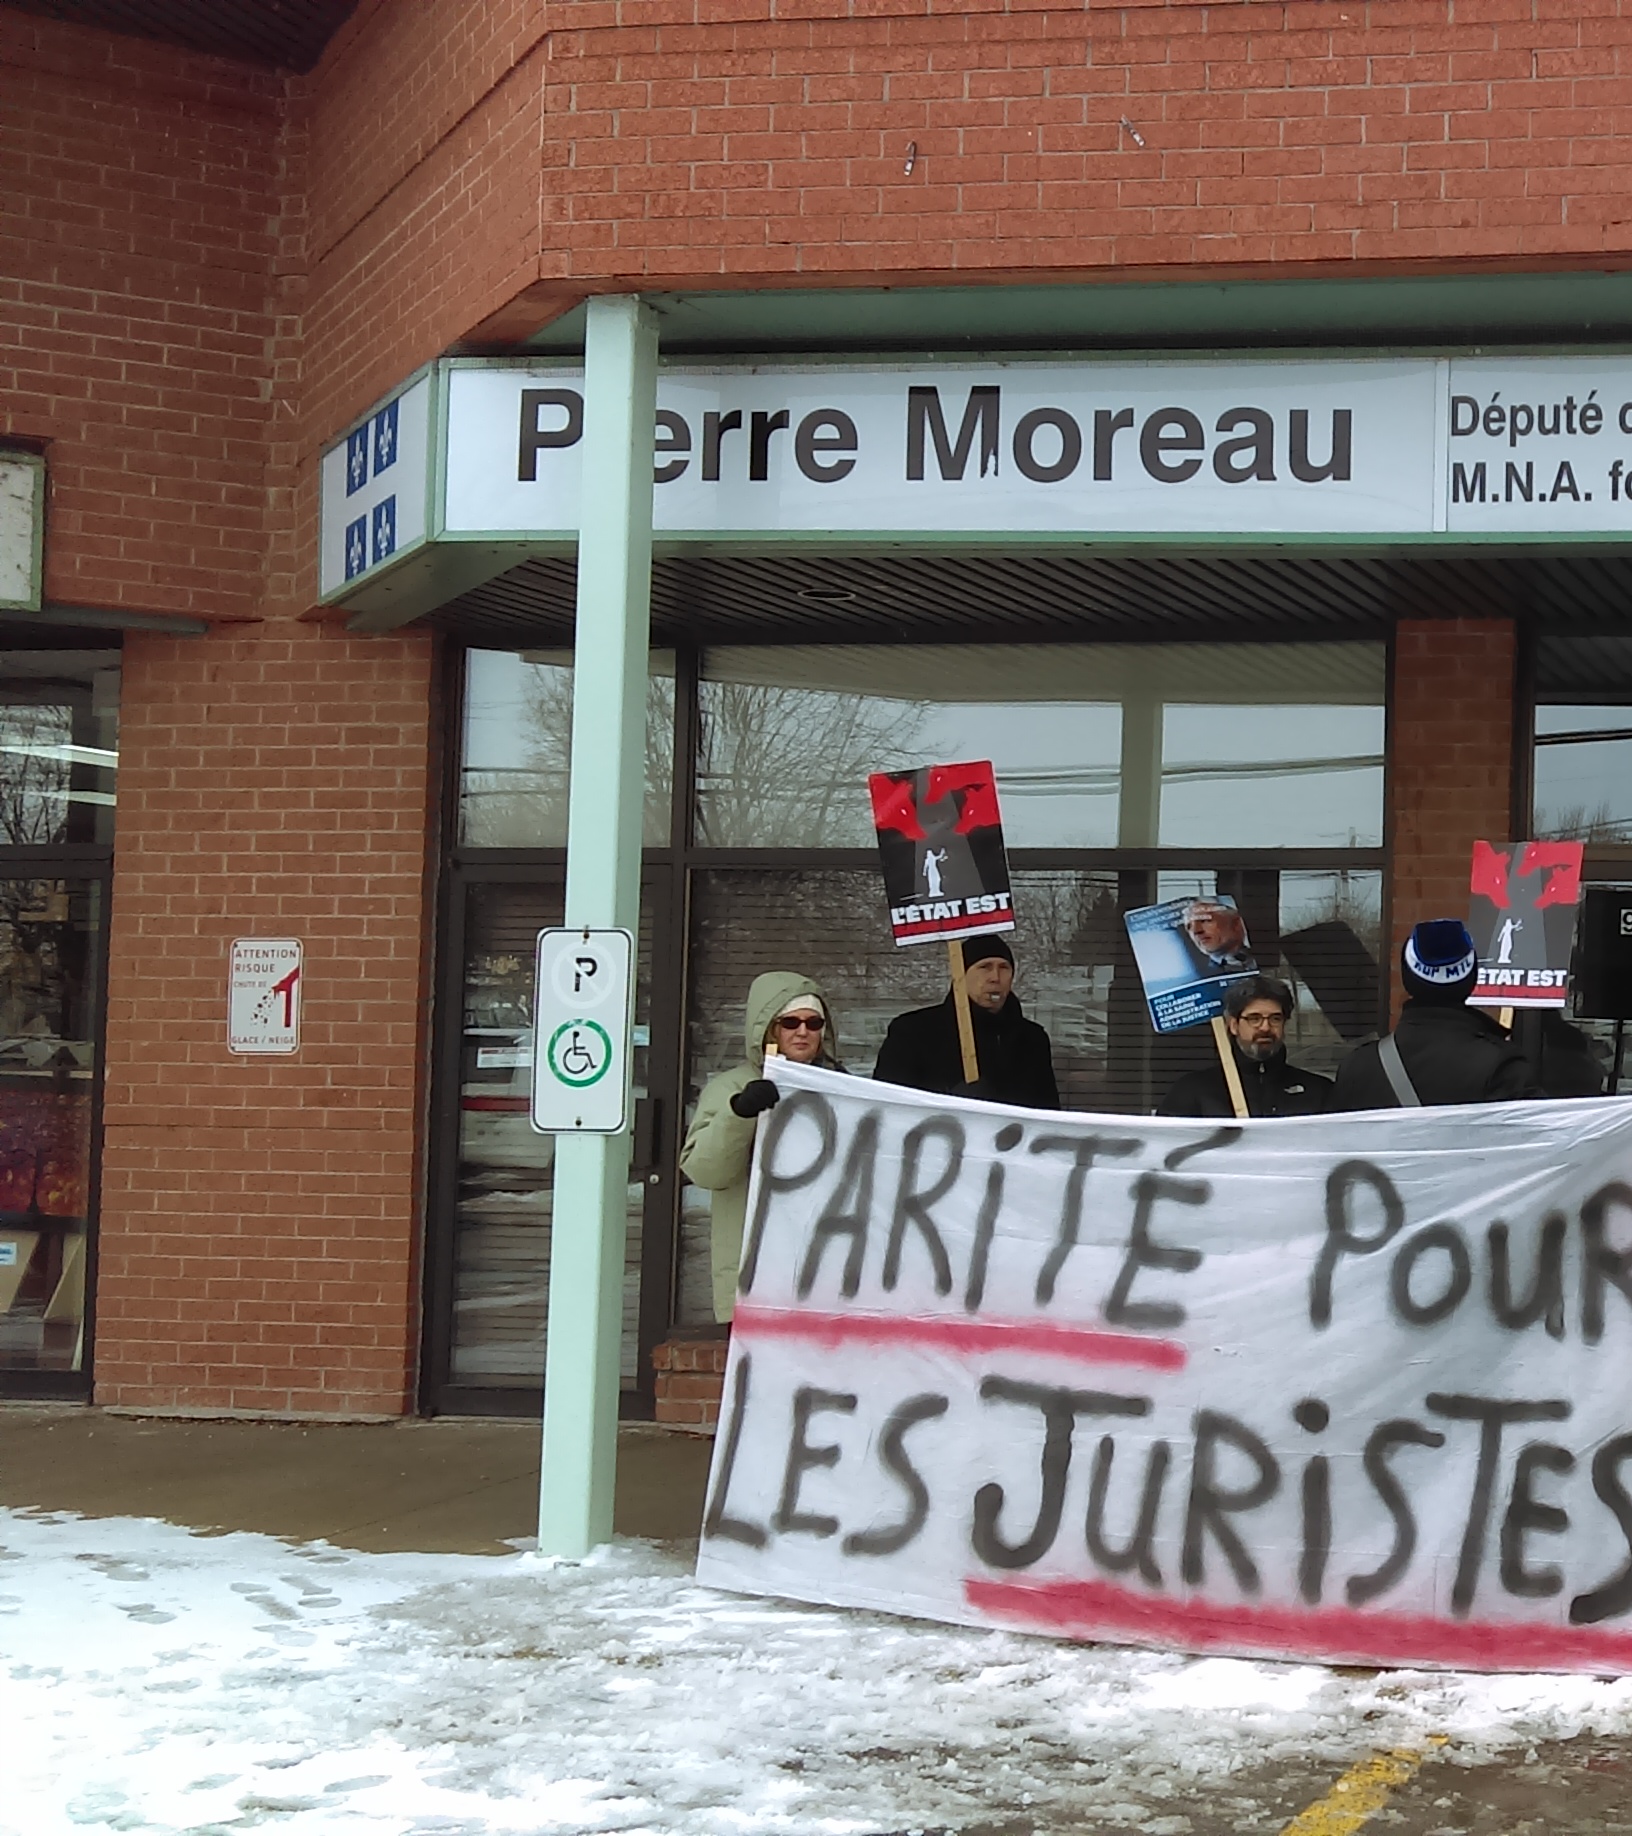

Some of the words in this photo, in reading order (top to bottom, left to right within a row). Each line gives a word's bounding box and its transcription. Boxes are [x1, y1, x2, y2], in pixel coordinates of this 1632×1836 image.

[1449, 390, 1603, 447] Député
[518, 387, 858, 483] Perre
[906, 383, 1353, 483] Moreau
[1451, 460, 1593, 503] M.N.A.
[965, 892, 1010, 915] EST
[235, 949, 297, 959] ATTENTION
[235, 963, 276, 973] RISQUE
[1527, 969, 1568, 987] EST
[231, 1036, 259, 1044] GLACE
[268, 1035, 295, 1044] NEIGE
[704, 1352, 951, 1558] LES
